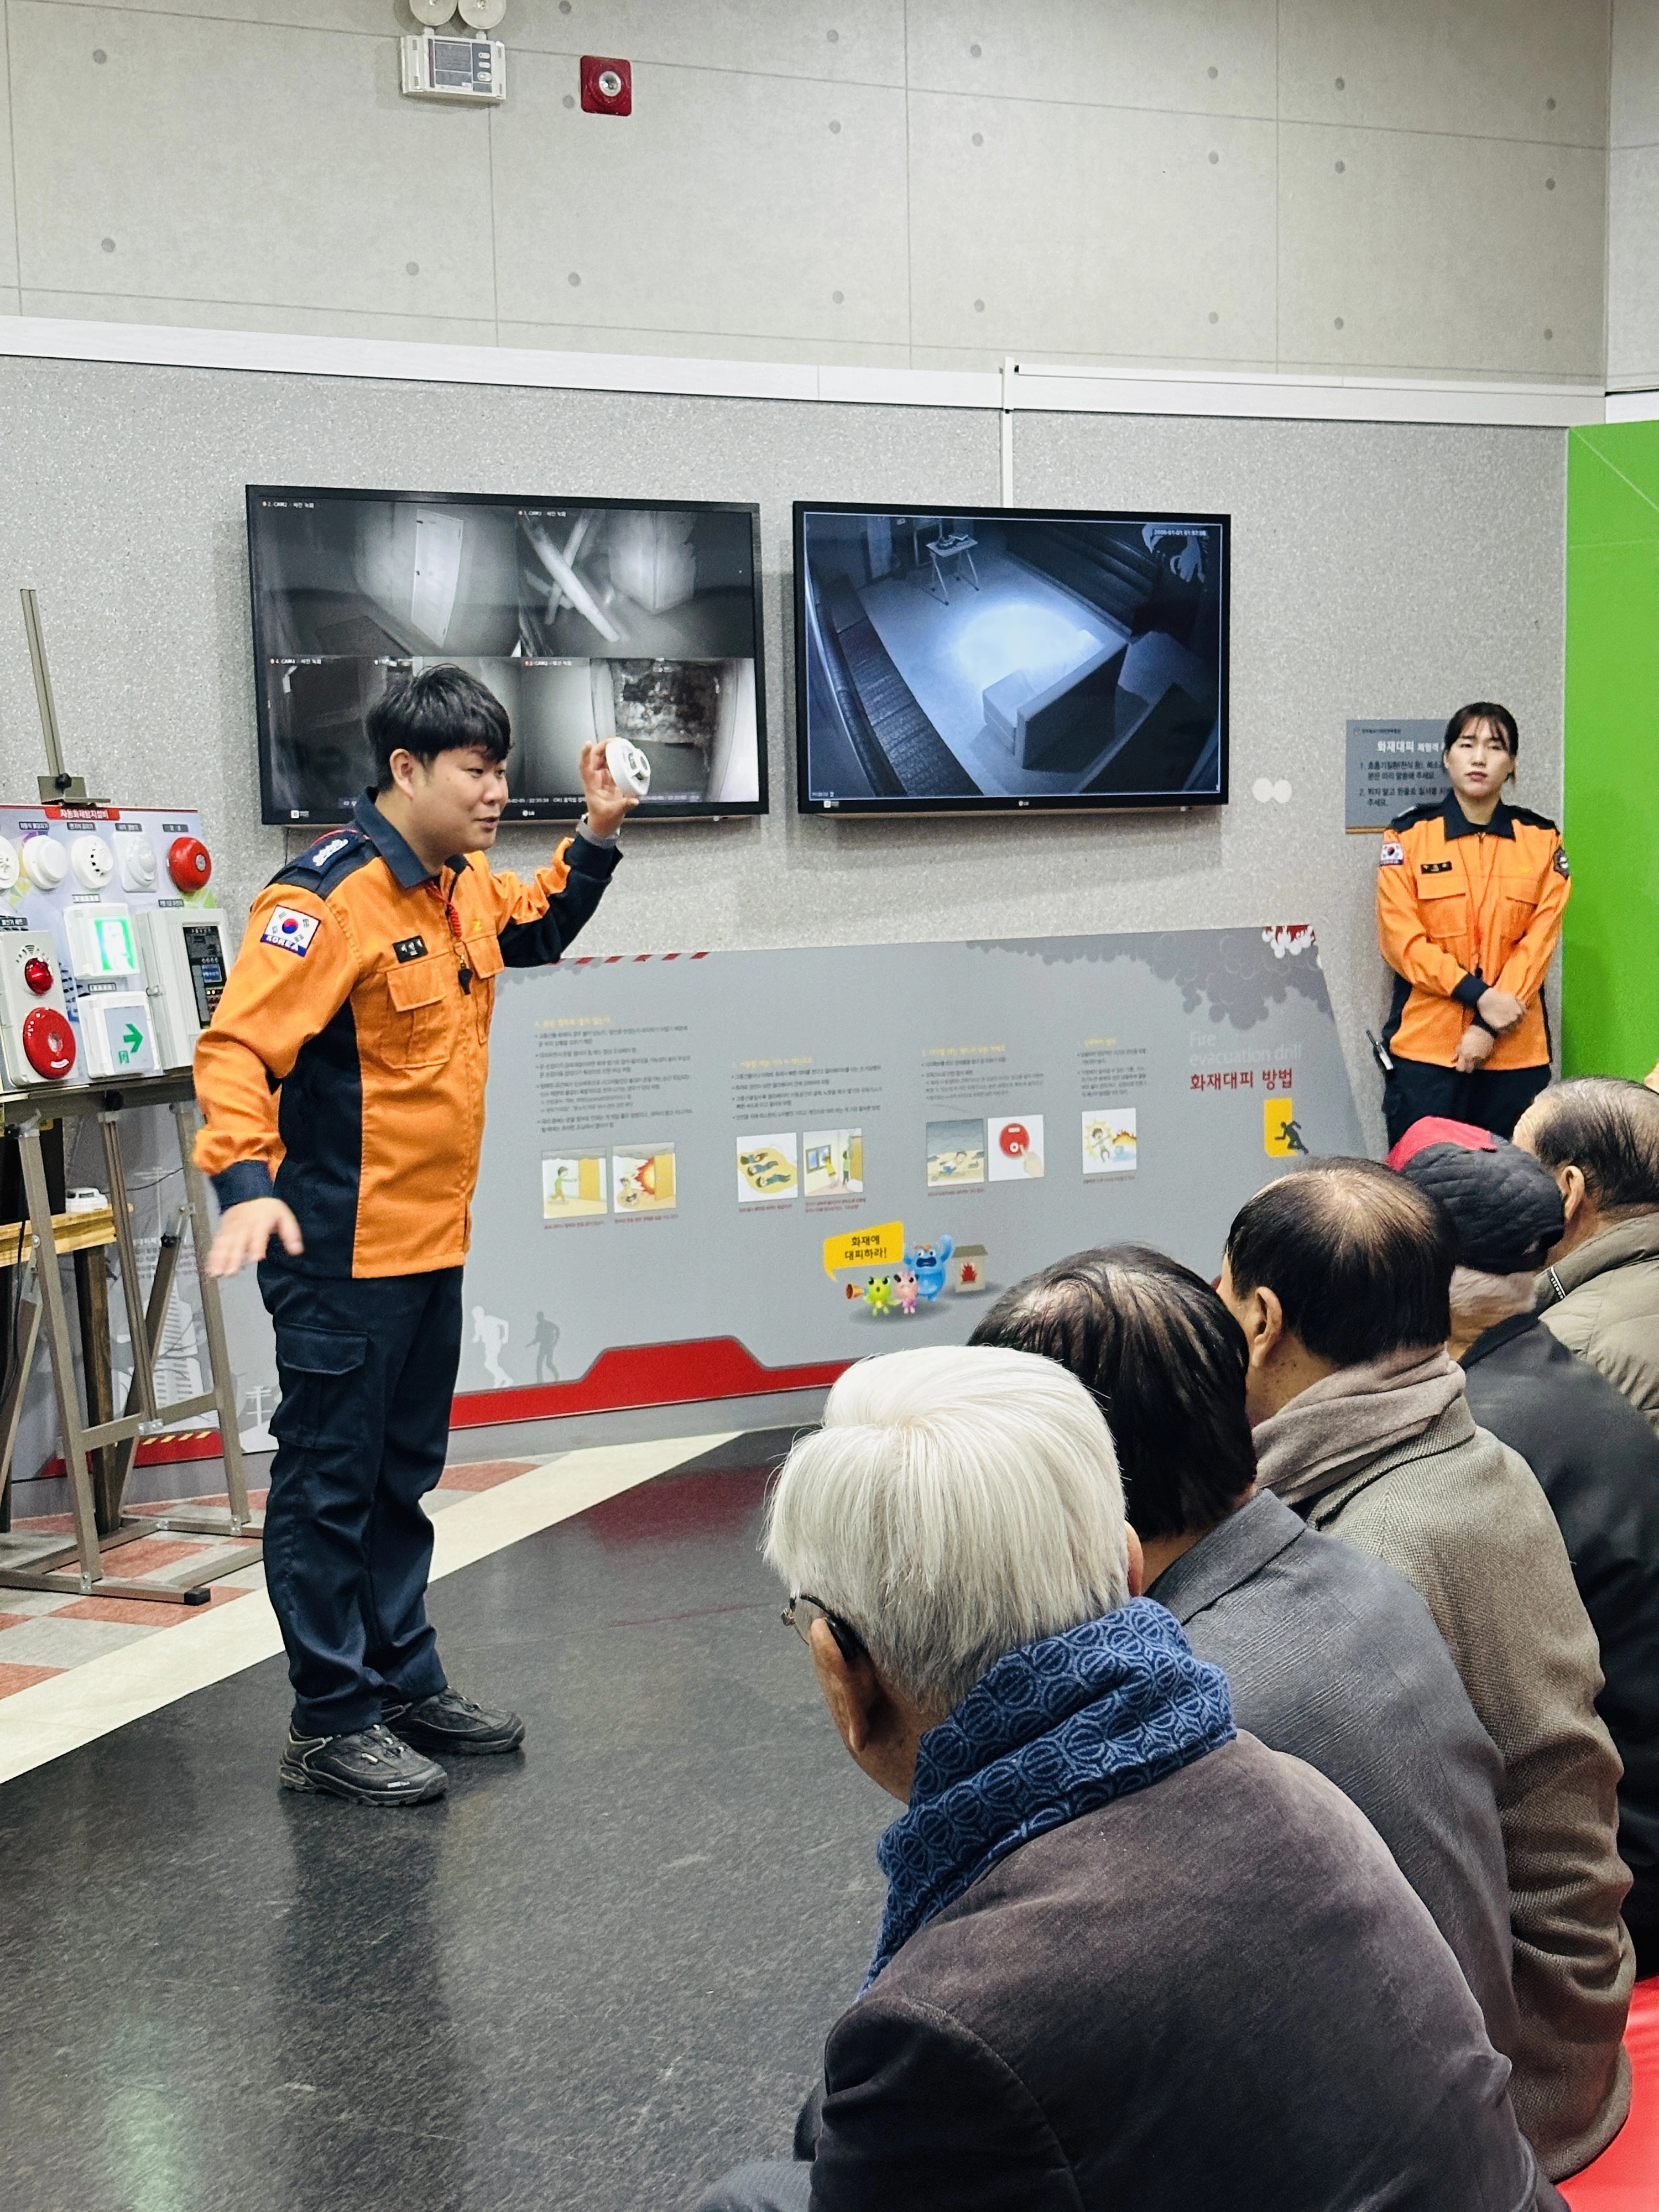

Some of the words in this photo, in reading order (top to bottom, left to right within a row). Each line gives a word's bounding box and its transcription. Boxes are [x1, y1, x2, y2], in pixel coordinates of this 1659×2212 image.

[1377, 740, 1414, 753] 화재대피
[60, 808, 109, 819] 자동화재탐지설비
[265, 935, 300, 952] KOREA
[1190, 1031, 1217, 1047] Fire
[1190, 1047, 1271, 1067] evacuation
[1274, 1041, 1302, 1061] drill
[1190, 1070, 1254, 1091] 화재대피
[1262, 1068, 1292, 1091] 방법
[851, 1235, 880, 1247] 화재에
[844, 1246, 887, 1260] 대피하라!
